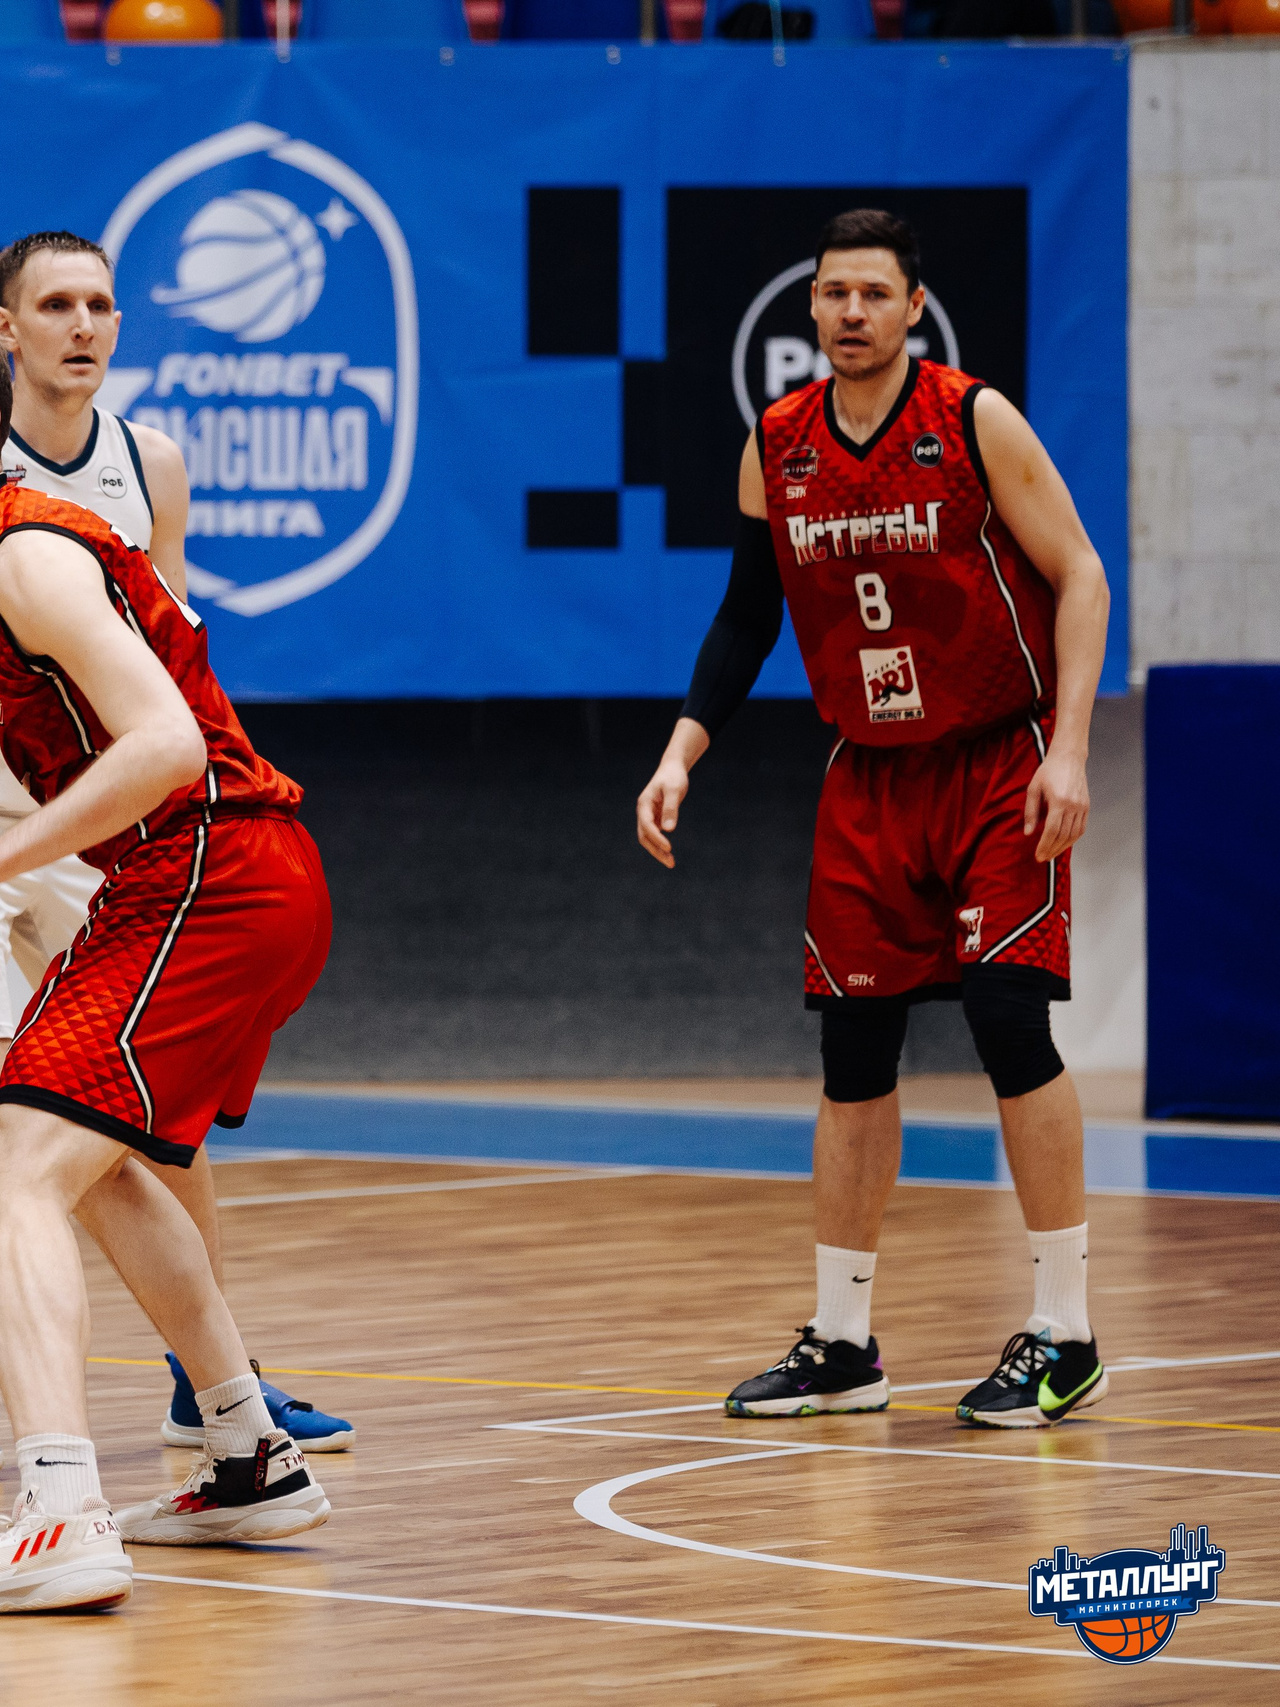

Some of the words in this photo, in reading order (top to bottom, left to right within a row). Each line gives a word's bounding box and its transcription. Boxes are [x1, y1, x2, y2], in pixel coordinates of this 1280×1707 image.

[153, 352, 350, 397] FONBET
[102, 478, 124, 488] РФБ
[185, 499, 326, 538] ЛИГА
[854, 572, 893, 632] 8
[847, 974, 876, 987] STK
